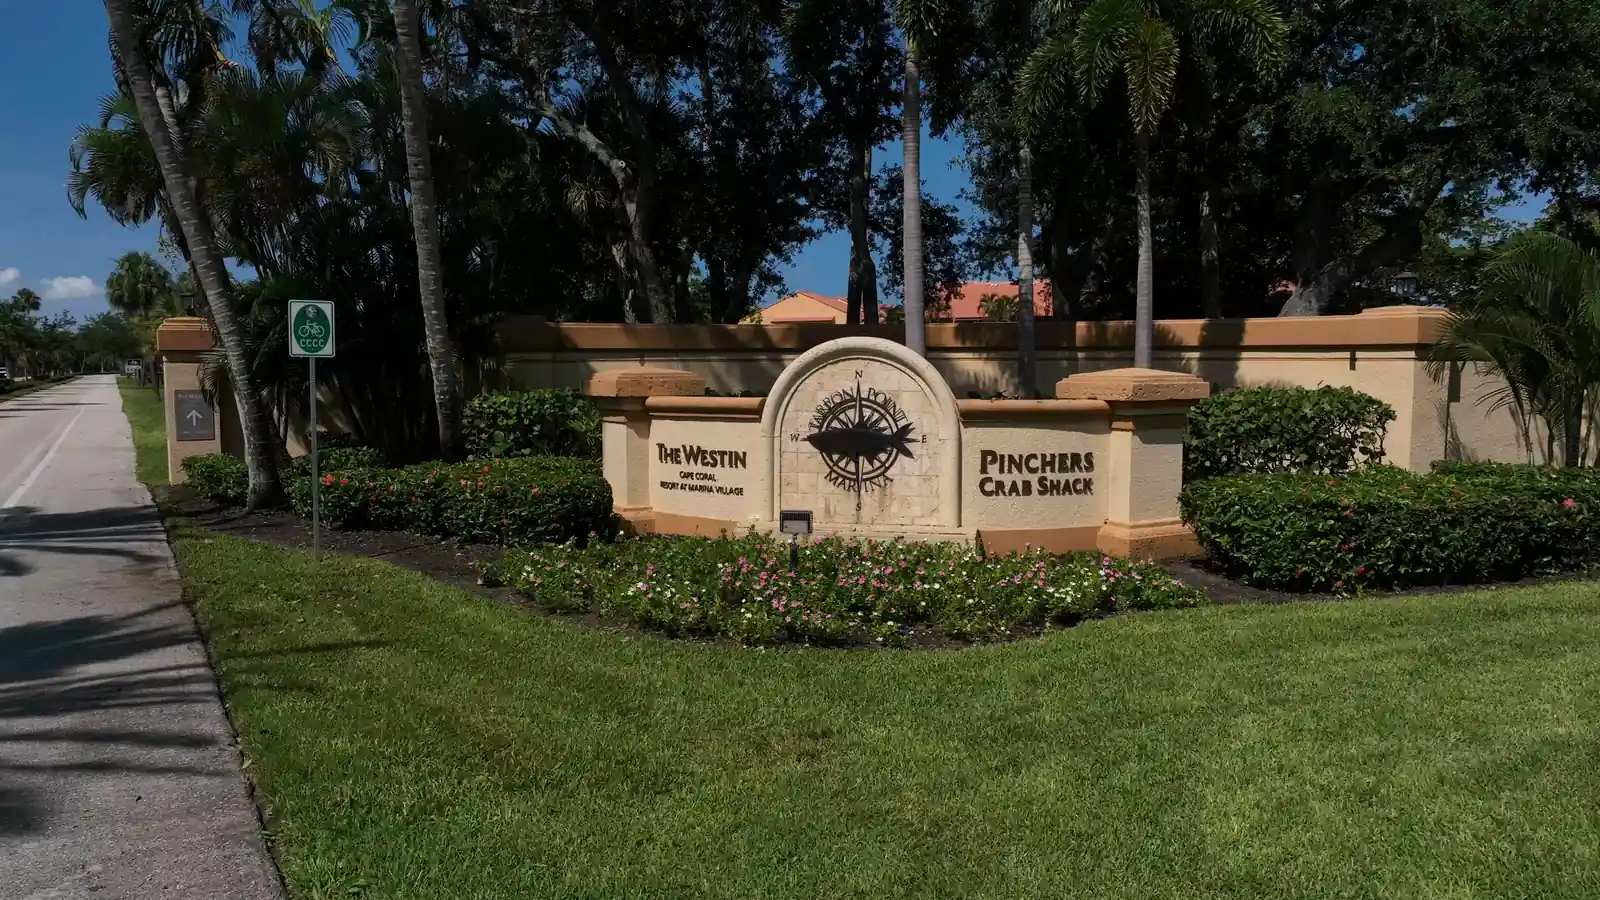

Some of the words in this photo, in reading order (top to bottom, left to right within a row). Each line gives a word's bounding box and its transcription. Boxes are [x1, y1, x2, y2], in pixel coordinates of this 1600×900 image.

[300, 339, 325, 348] CCCC
[855, 370, 863, 379] N
[867, 387, 909, 422] POINT
[790, 433, 800, 442] W
[921, 434, 927, 444] E
[681, 444, 747, 469] WESTIN
[980, 449, 1095, 475] PINCHERS
[679, 471, 694, 480] CAPE
[695, 472, 716, 482] CORAL
[824, 470, 894, 493] MARINA
[660, 480, 679, 491] RESORT
[680, 483, 687, 491] AT
[688, 483, 714, 494] MARINA
[715, 486, 744, 496] VILLAGE
[978, 476, 1033, 497] CRAB
[1037, 476, 1094, 496] SHACK
[855, 503, 862, 512] S
